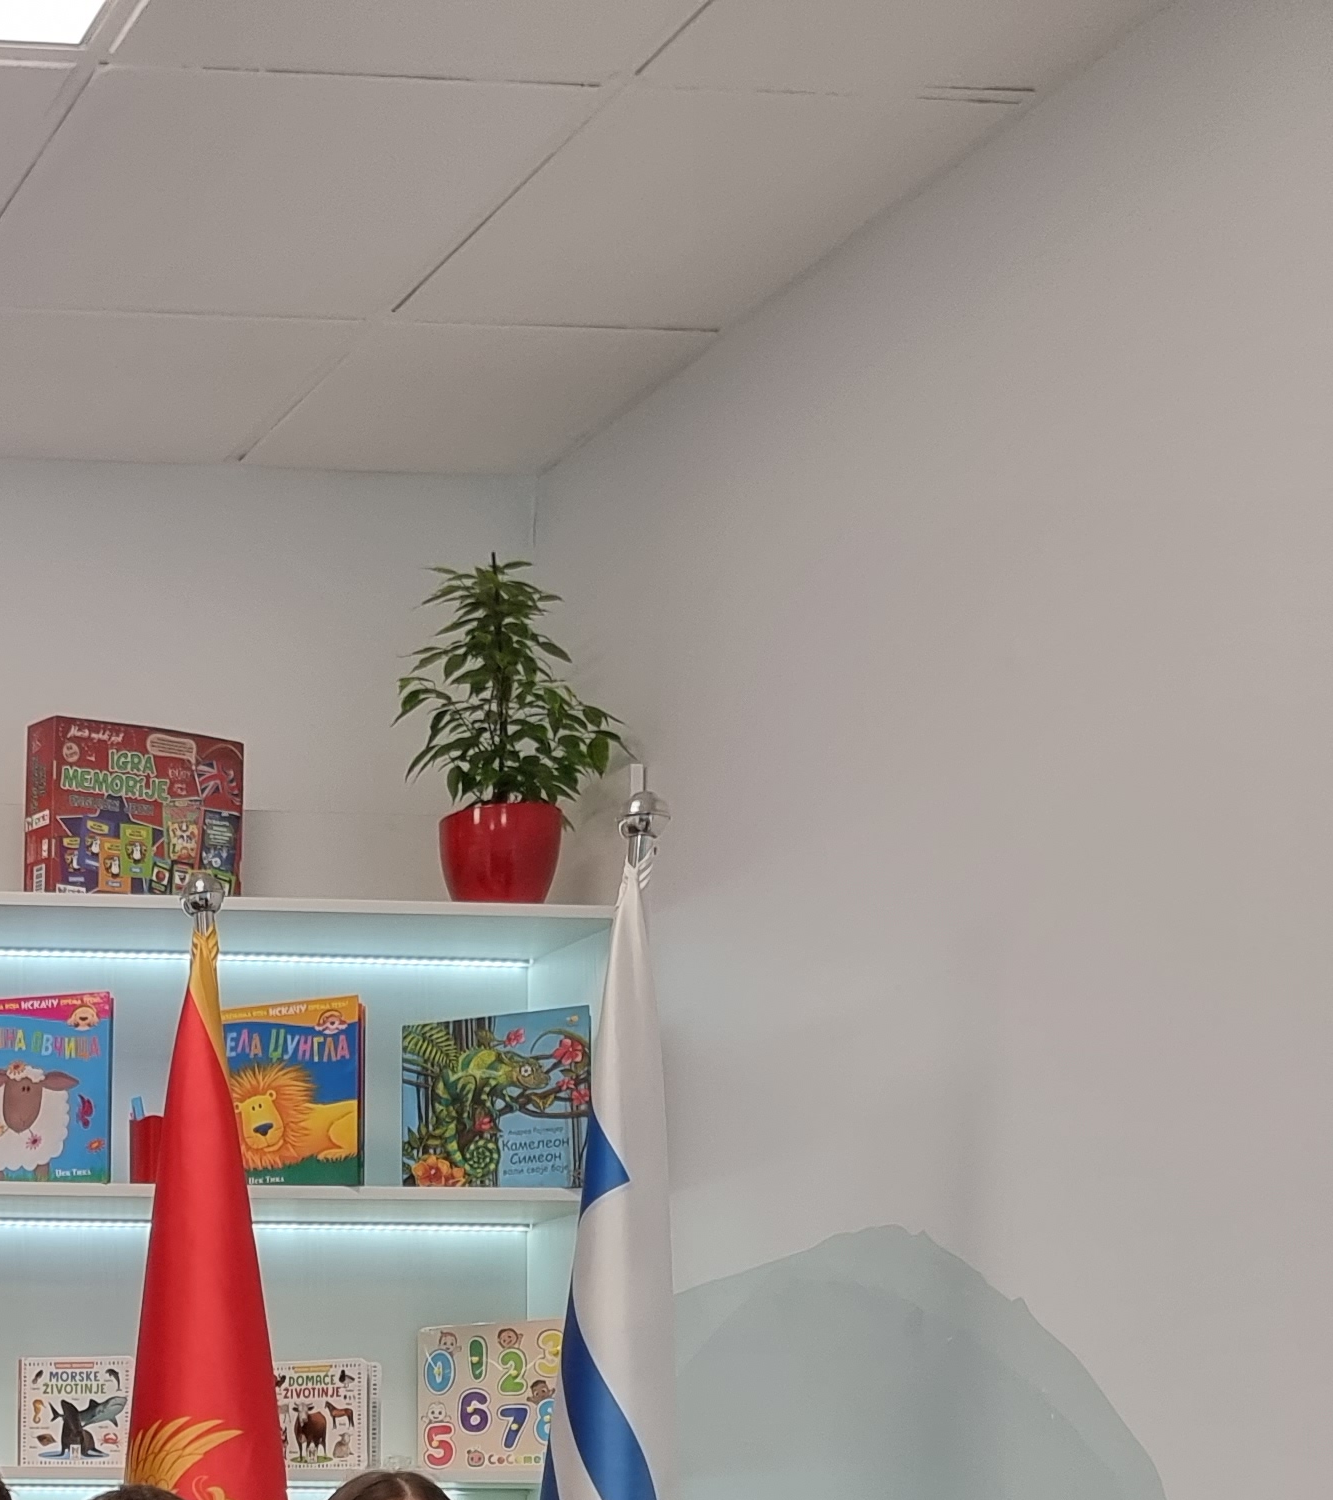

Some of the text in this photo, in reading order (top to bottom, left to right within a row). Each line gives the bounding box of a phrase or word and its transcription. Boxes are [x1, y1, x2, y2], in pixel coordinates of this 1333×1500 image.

[109, 749, 156, 777] IGRA
[62, 766, 170, 803] MEMORIJE
[225, 1028, 350, 1062] ЕЛА ЏУНГЛА
[502, 1137, 570, 1152] Камелеон
[509, 1152, 562, 1165] Симеон
[49, 1370, 101, 1382] MORSKE
[288, 1373, 337, 1388] DOMAĆE
[498, 1348, 528, 1396] 2
[42, 1382, 107, 1395] ŽIVOTINJE
[282, 1386, 342, 1399] ŽIVOTINJE
[458, 1387, 492, 1435] 6
[497, 1403, 530, 1451] 7
[424, 1422, 456, 1470] 5
